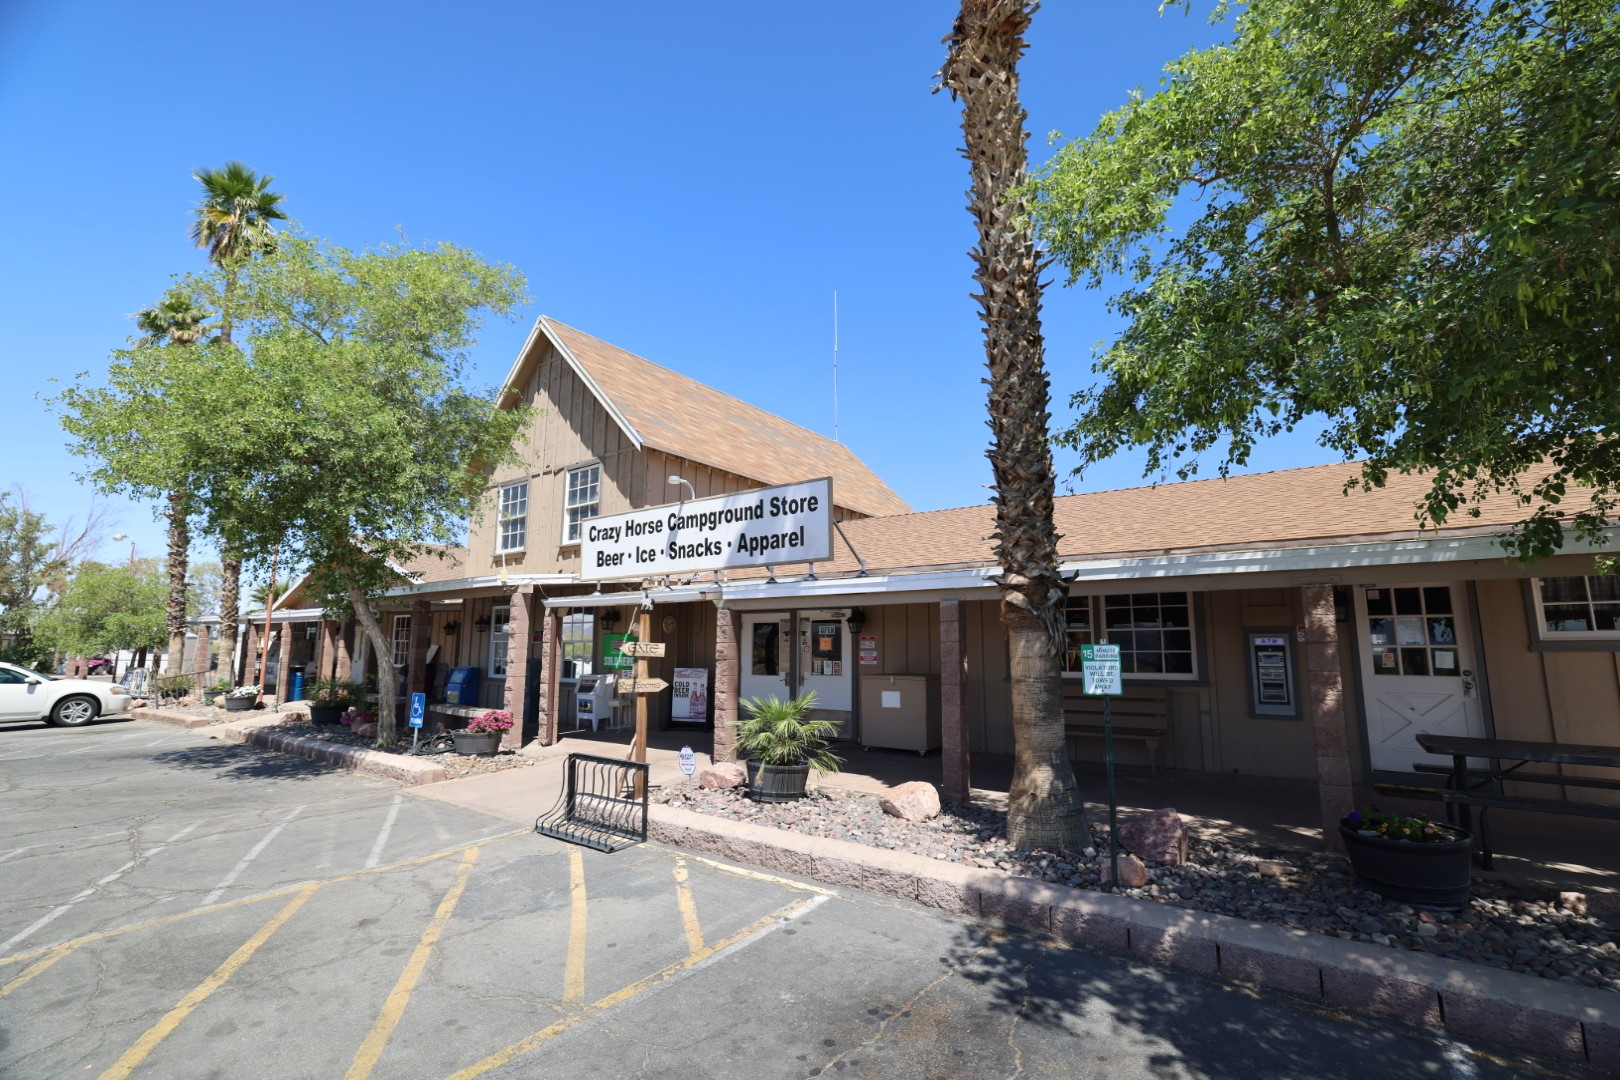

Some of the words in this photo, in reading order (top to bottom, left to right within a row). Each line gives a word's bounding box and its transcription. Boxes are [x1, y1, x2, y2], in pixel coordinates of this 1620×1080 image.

[589, 524, 622, 544] Crazy
[625, 518, 663, 538] Horse
[667, 499, 764, 532] Campground
[769, 495, 819, 517] Store
[596, 550, 625, 568] Beer
[635, 545, 656, 563] Ice
[668, 538, 722, 560] Snacks
[736, 525, 805, 557] Apparel
[1082, 650, 1093, 659] 15
